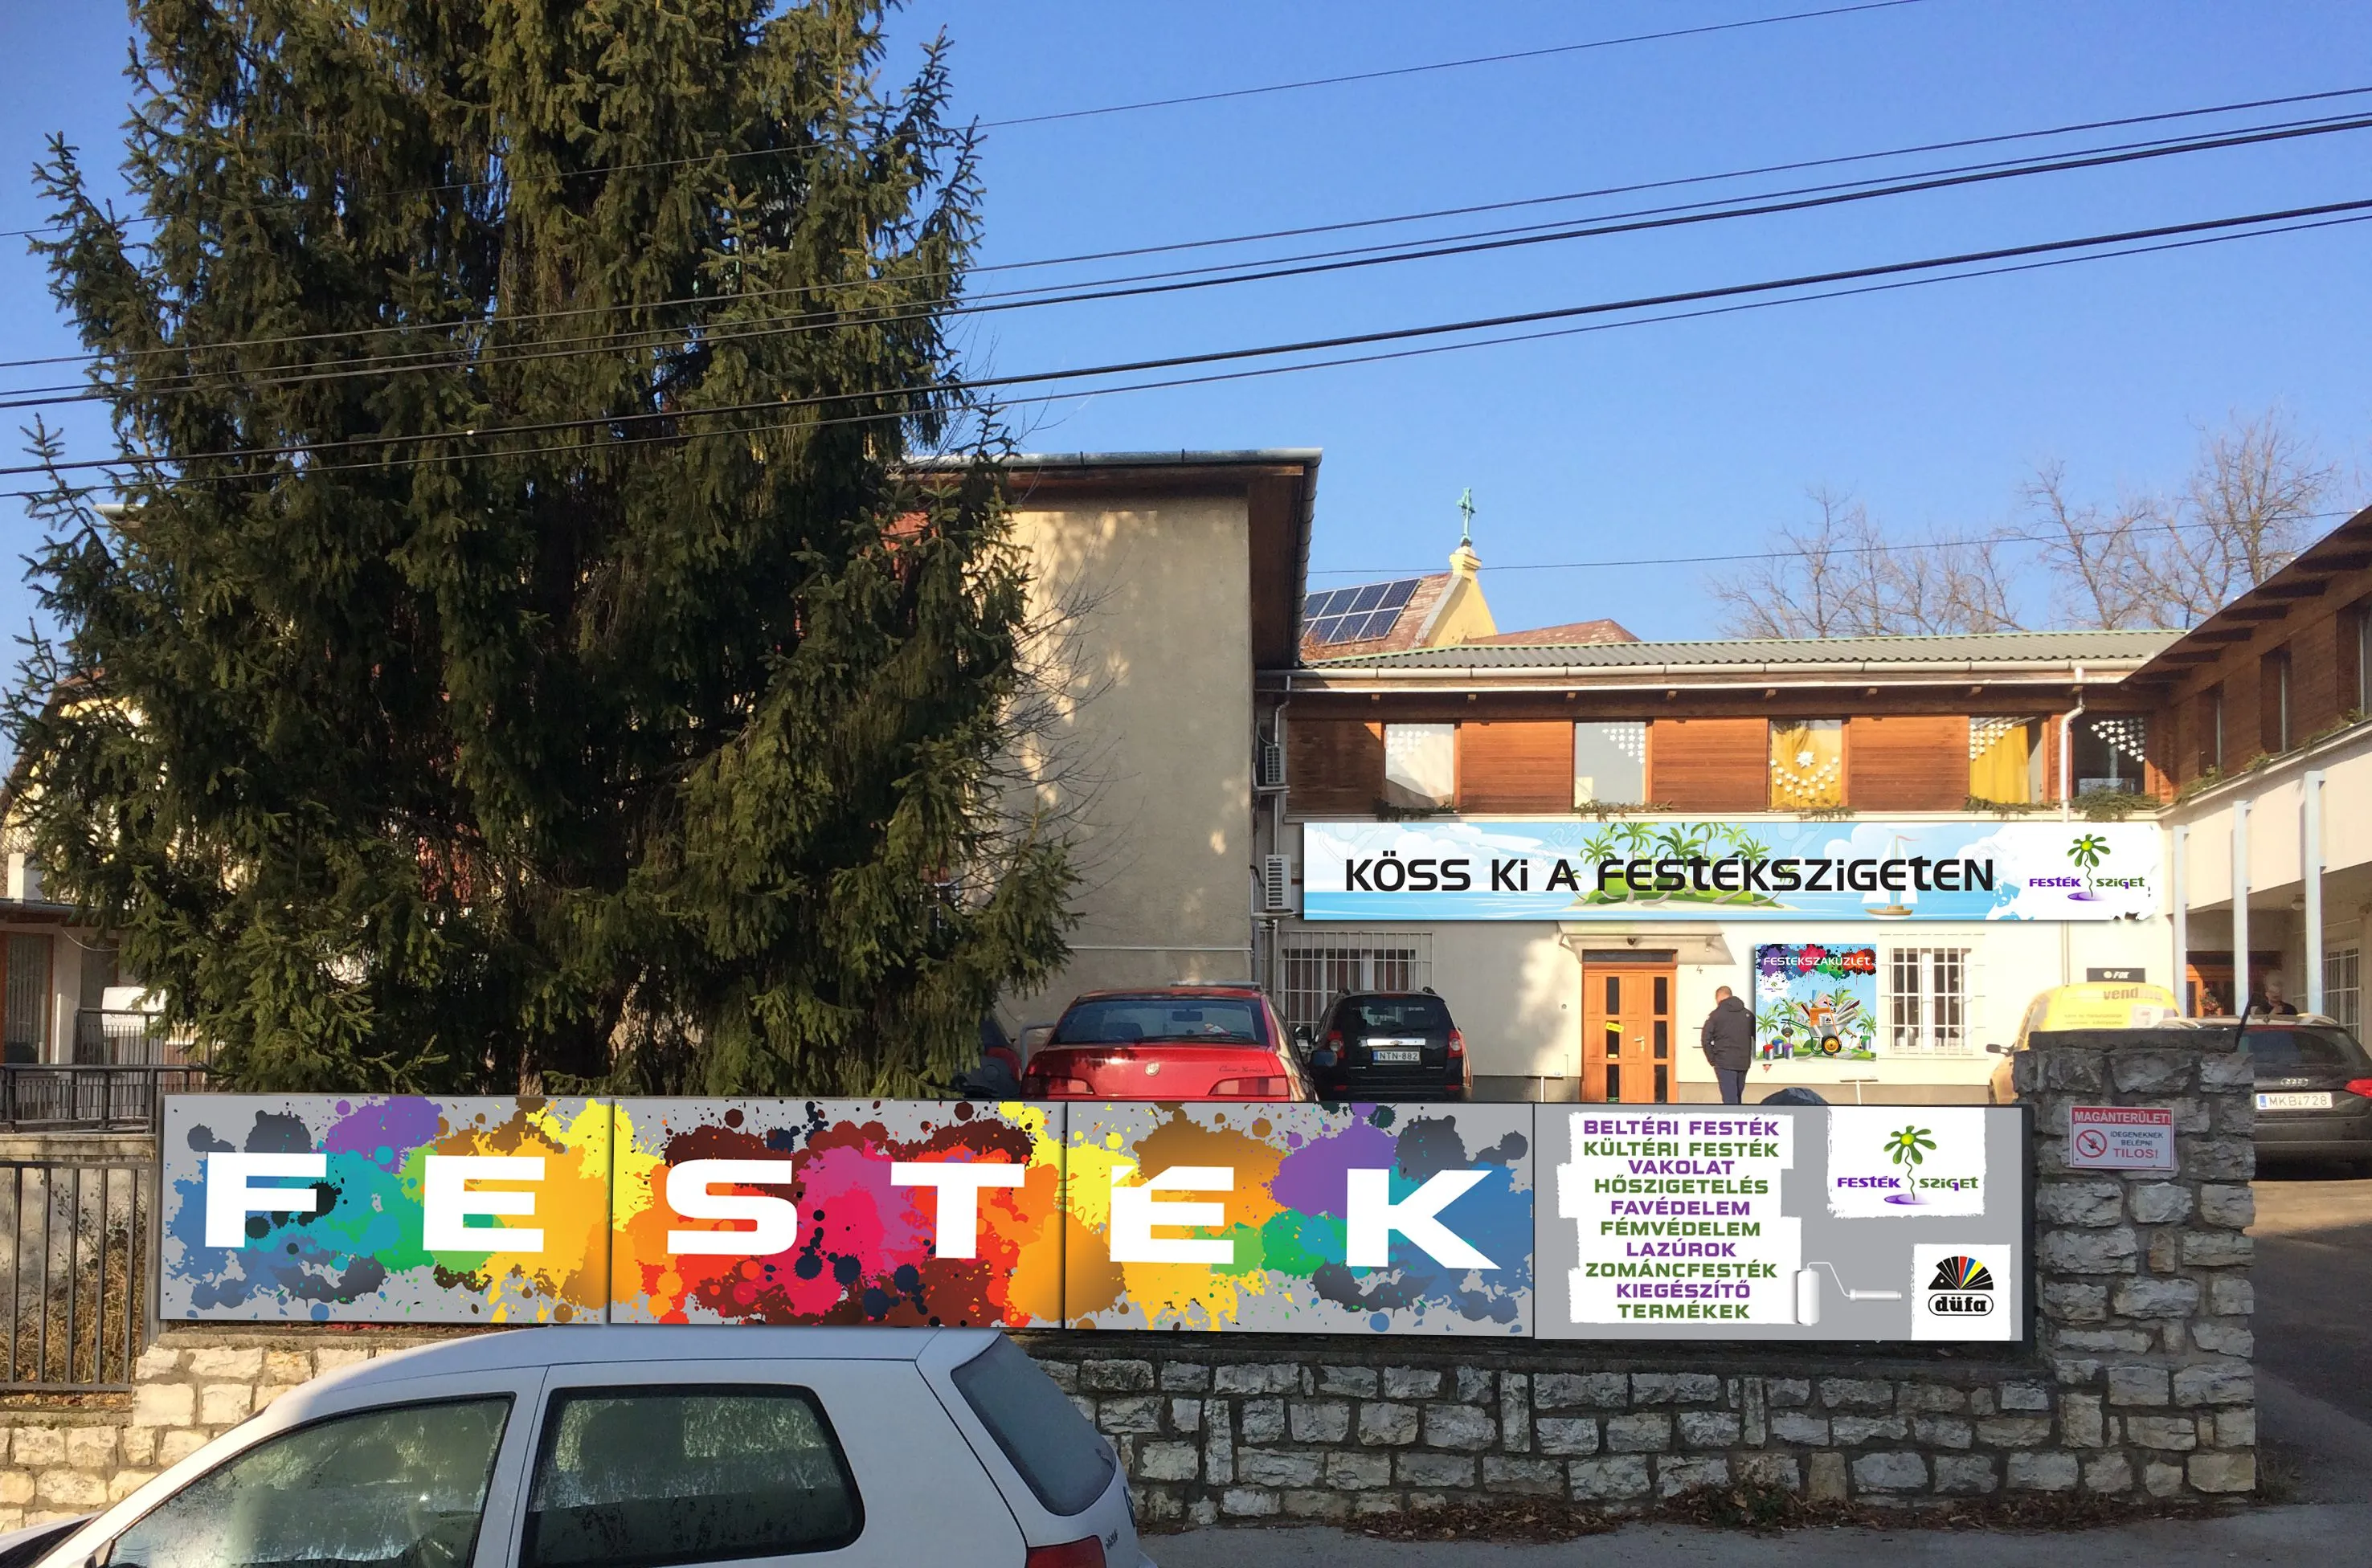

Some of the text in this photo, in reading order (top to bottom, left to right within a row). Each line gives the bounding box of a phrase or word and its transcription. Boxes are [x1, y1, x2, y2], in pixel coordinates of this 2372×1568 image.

[1346, 851, 1470, 892] KÖSS
[1546, 860, 1579, 891] A
[1379, 1051, 1418, 1061] NTN-882
[1584, 1117, 1779, 1136] BELTÉRI FESTÉK
[1584, 1137, 1779, 1157] KÜLTÉRI FESTÉK
[2113, 1148, 2159, 1159] TILOS!
[1628, 1160, 1735, 1175] VAKOLAT
[1594, 1175, 1769, 1194] HŐSZIGETELÉS
[1611, 1198, 1750, 1215] FAVÉDELEM
[1601, 1218, 1761, 1236] FÉMVÉDELEM
[1626, 1239, 1736, 1257] LAZÚROK
[1585, 1260, 1777, 1278] ZOMÁNCFESTÉK
[1617, 1280, 1750, 1299] KIEGÉSZÍTŐ
[1617, 1301, 1749, 1319] TERMÉKEK
[1935, 1296, 1987, 1312] düfa
